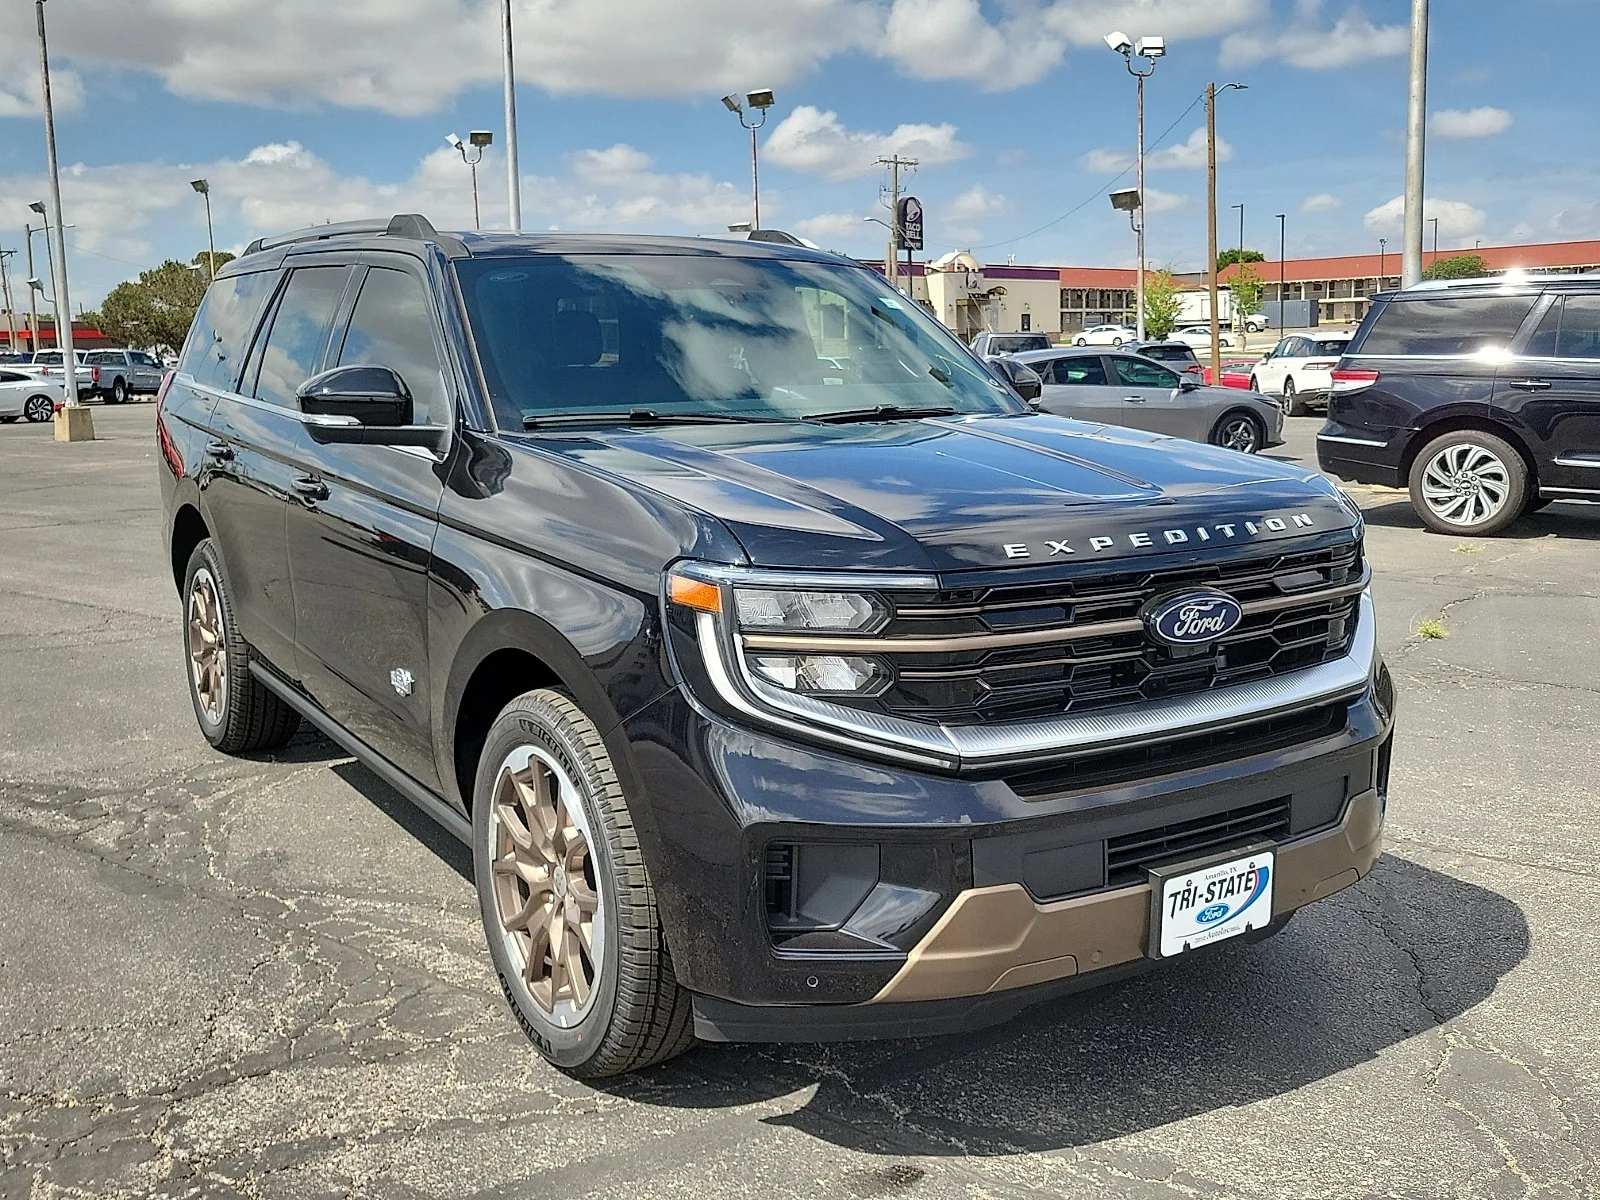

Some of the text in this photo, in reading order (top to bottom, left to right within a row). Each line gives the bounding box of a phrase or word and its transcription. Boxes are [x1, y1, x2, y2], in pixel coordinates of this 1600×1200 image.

[905, 222, 921, 231] TACO
[906, 231, 920, 239] BELL
[1002, 513, 1314, 559] EXPEDITION
[1173, 604, 1227, 637] Ford
[1168, 869, 1257, 919] TRI-STATE
[1201, 906, 1225, 922] Ford
